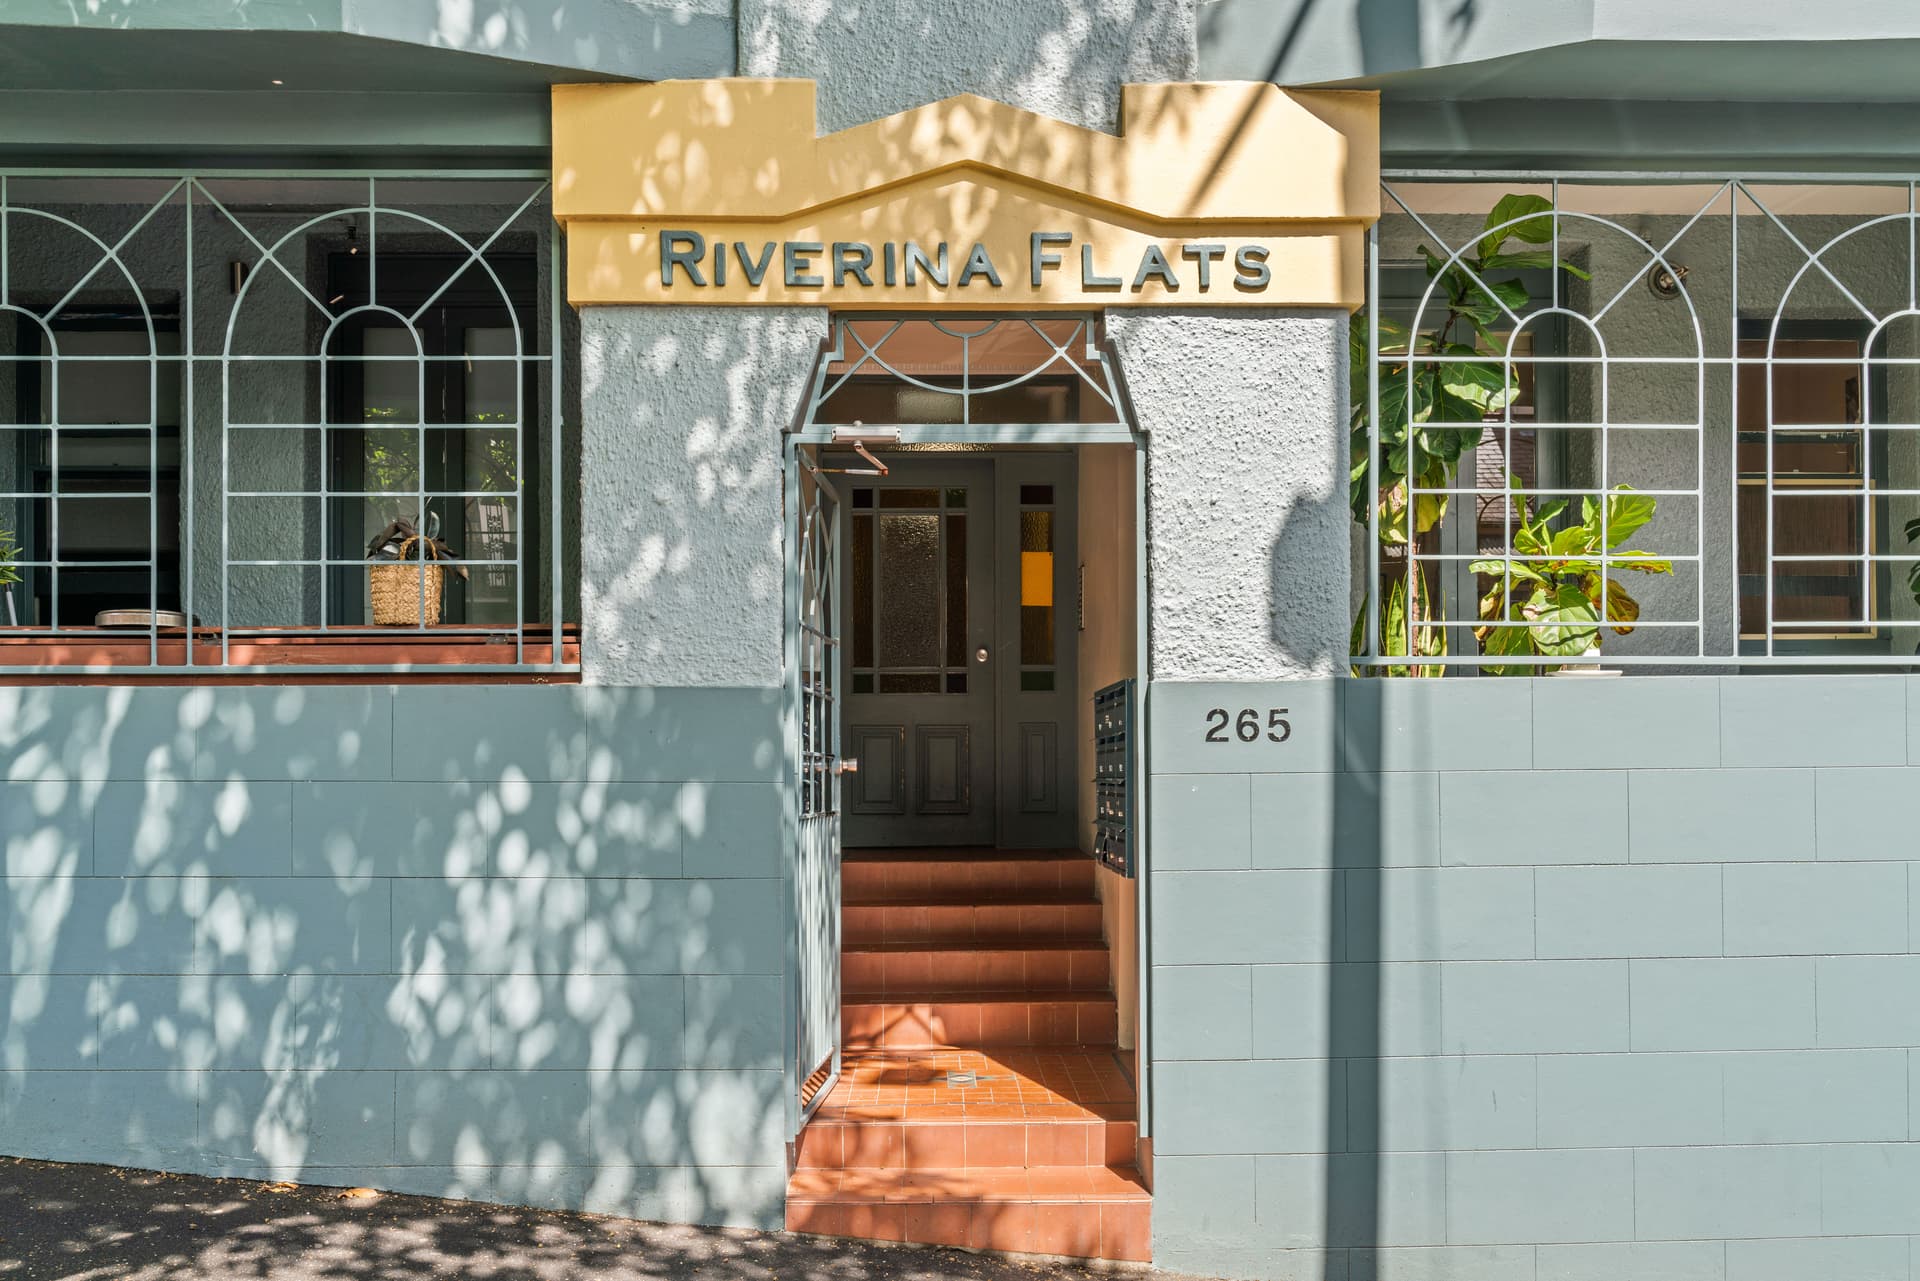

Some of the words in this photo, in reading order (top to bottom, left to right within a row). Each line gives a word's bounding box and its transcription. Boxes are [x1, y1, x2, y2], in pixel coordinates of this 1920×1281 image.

[659, 230, 1002, 287] RIVERINA
[1031, 231, 1271, 291] FLATS
[1205, 708, 1292, 743] 265
